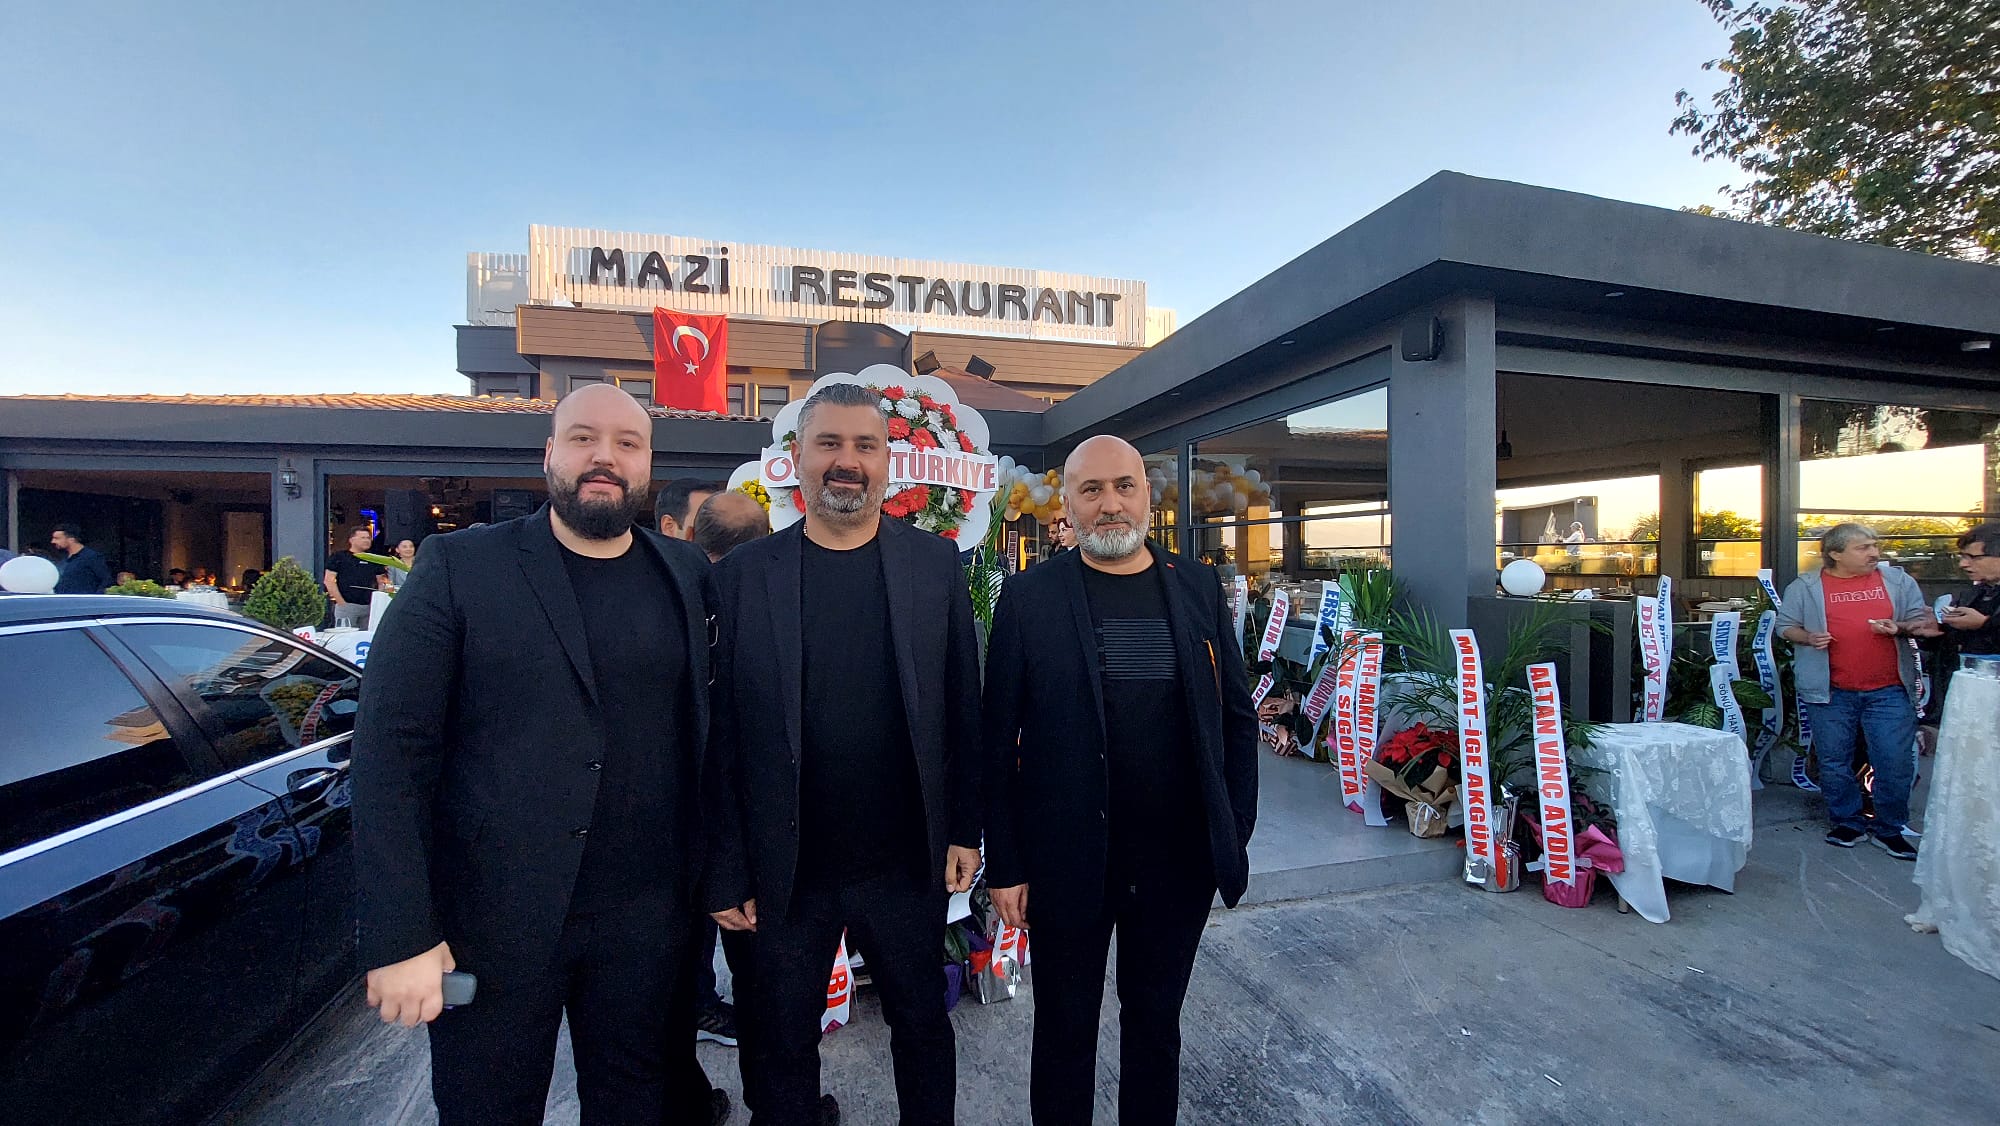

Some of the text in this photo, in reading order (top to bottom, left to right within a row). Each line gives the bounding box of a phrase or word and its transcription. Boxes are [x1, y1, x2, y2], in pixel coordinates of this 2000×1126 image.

[791, 265, 1122, 327] RESTAURANT
[891, 451, 996, 489] TÜRKİYE
[1830, 586, 1885, 603] mavi
[1641, 604, 1661, 685] DETAY
[1718, 683, 1734, 713] GÖNÜL
[1337, 695, 1360, 796] SİGORTA
[1529, 666, 1571, 880] ALTAN VİNÇ AYDIN
[1466, 773, 1489, 858] AKGÜN
